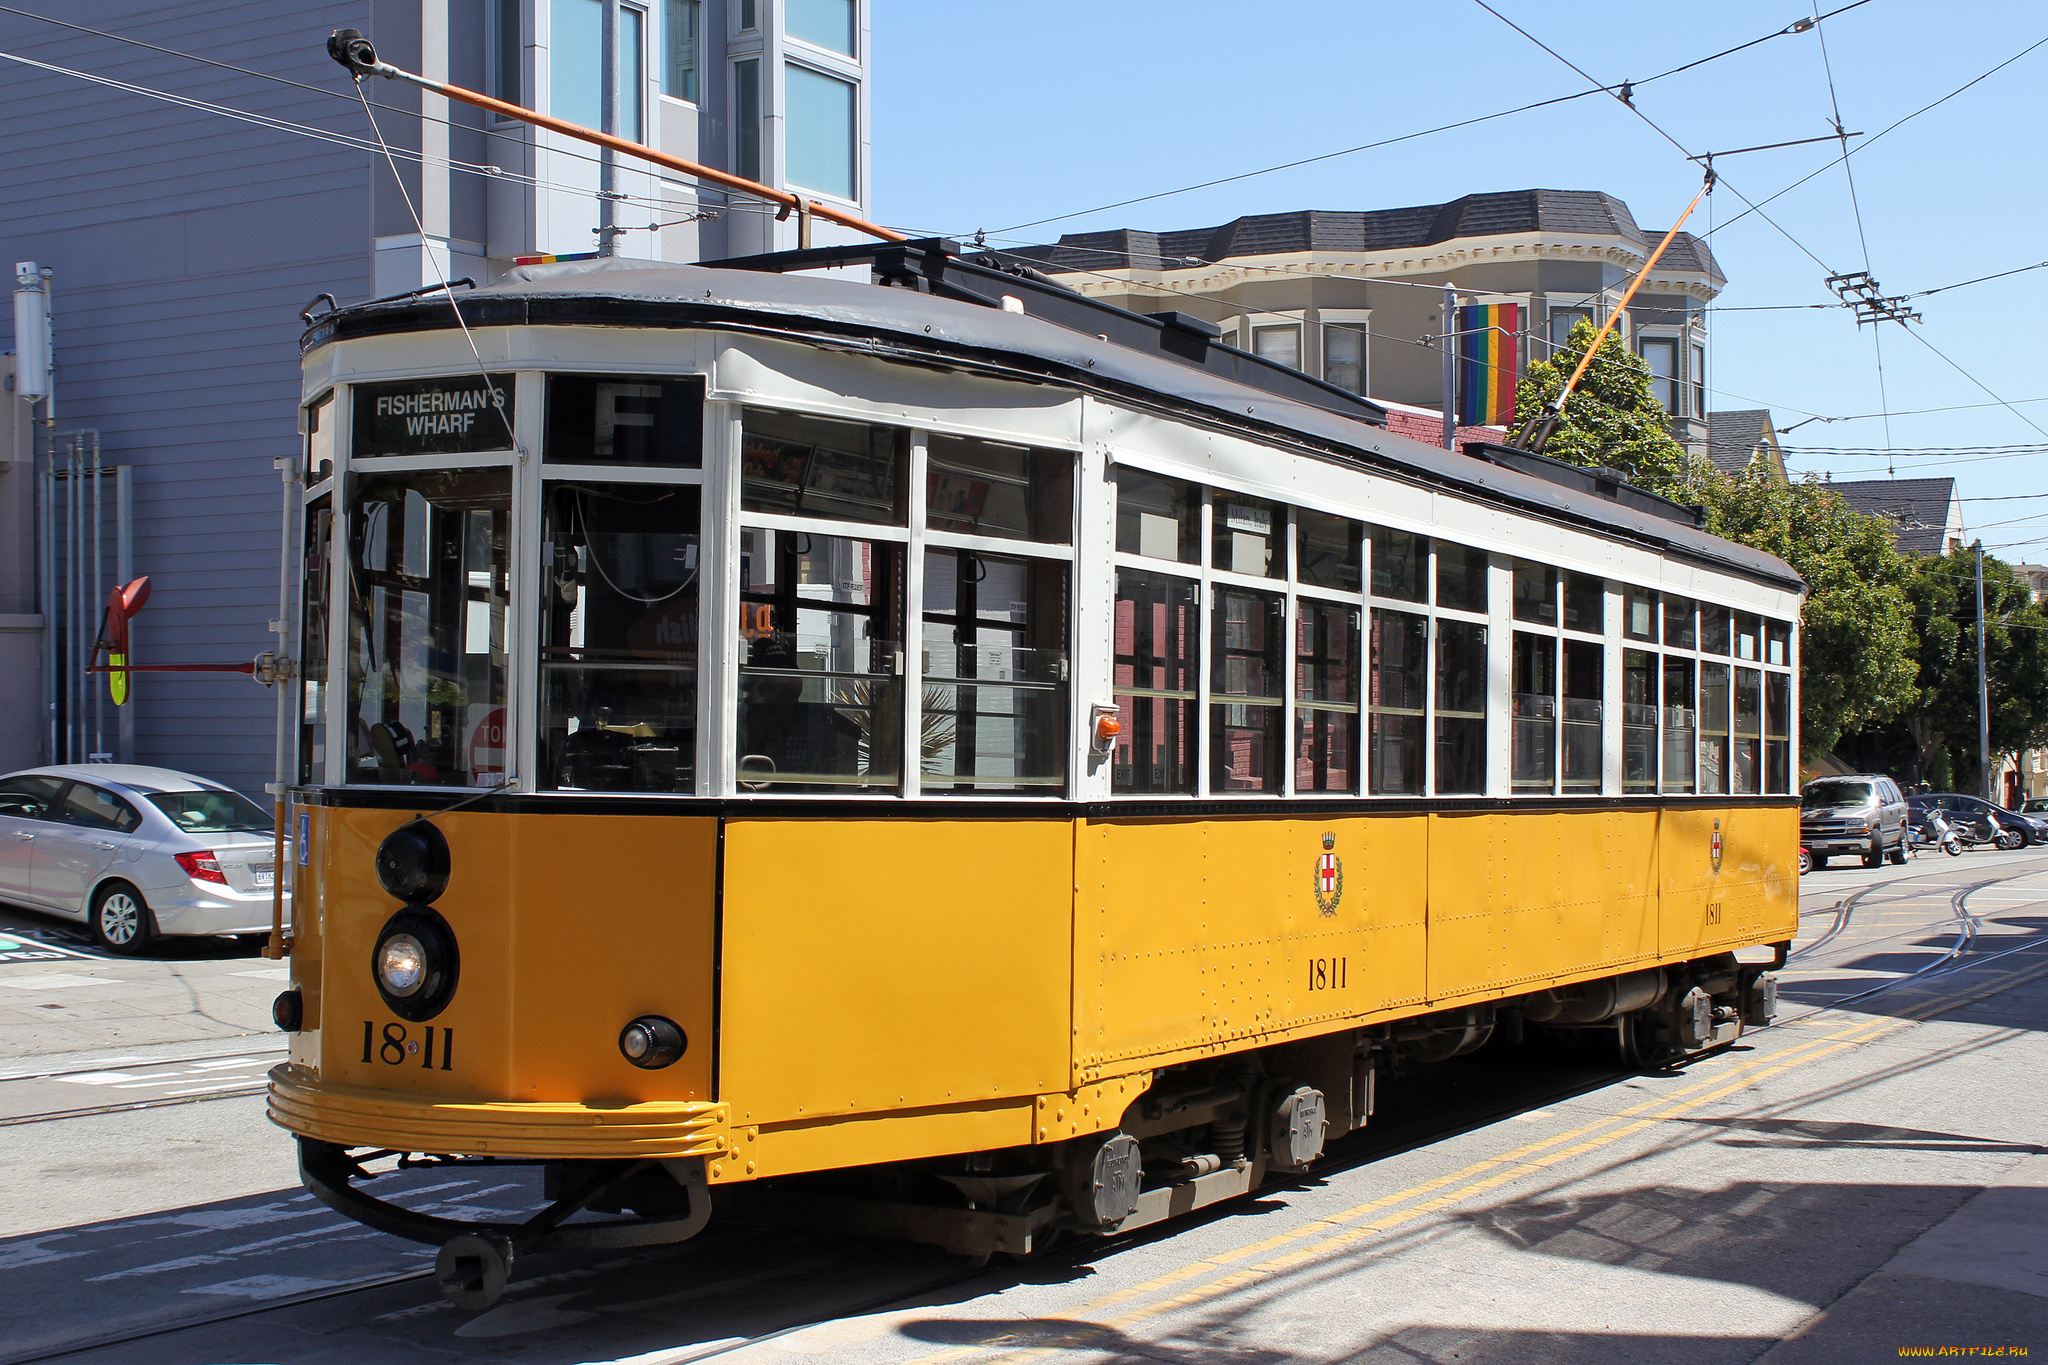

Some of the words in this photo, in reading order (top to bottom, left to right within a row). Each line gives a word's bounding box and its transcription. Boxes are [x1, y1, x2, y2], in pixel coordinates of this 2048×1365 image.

[377, 388, 506, 416] FISHERMAN'S
[406, 412, 475, 436] WHARF
[594, 382, 662, 456] F
[1116, 768, 1131, 780] EXIT
[1705, 903, 1722, 927] 1811
[1308, 957, 1347, 992] 1811
[360, 1020, 453, 1071] 1811
